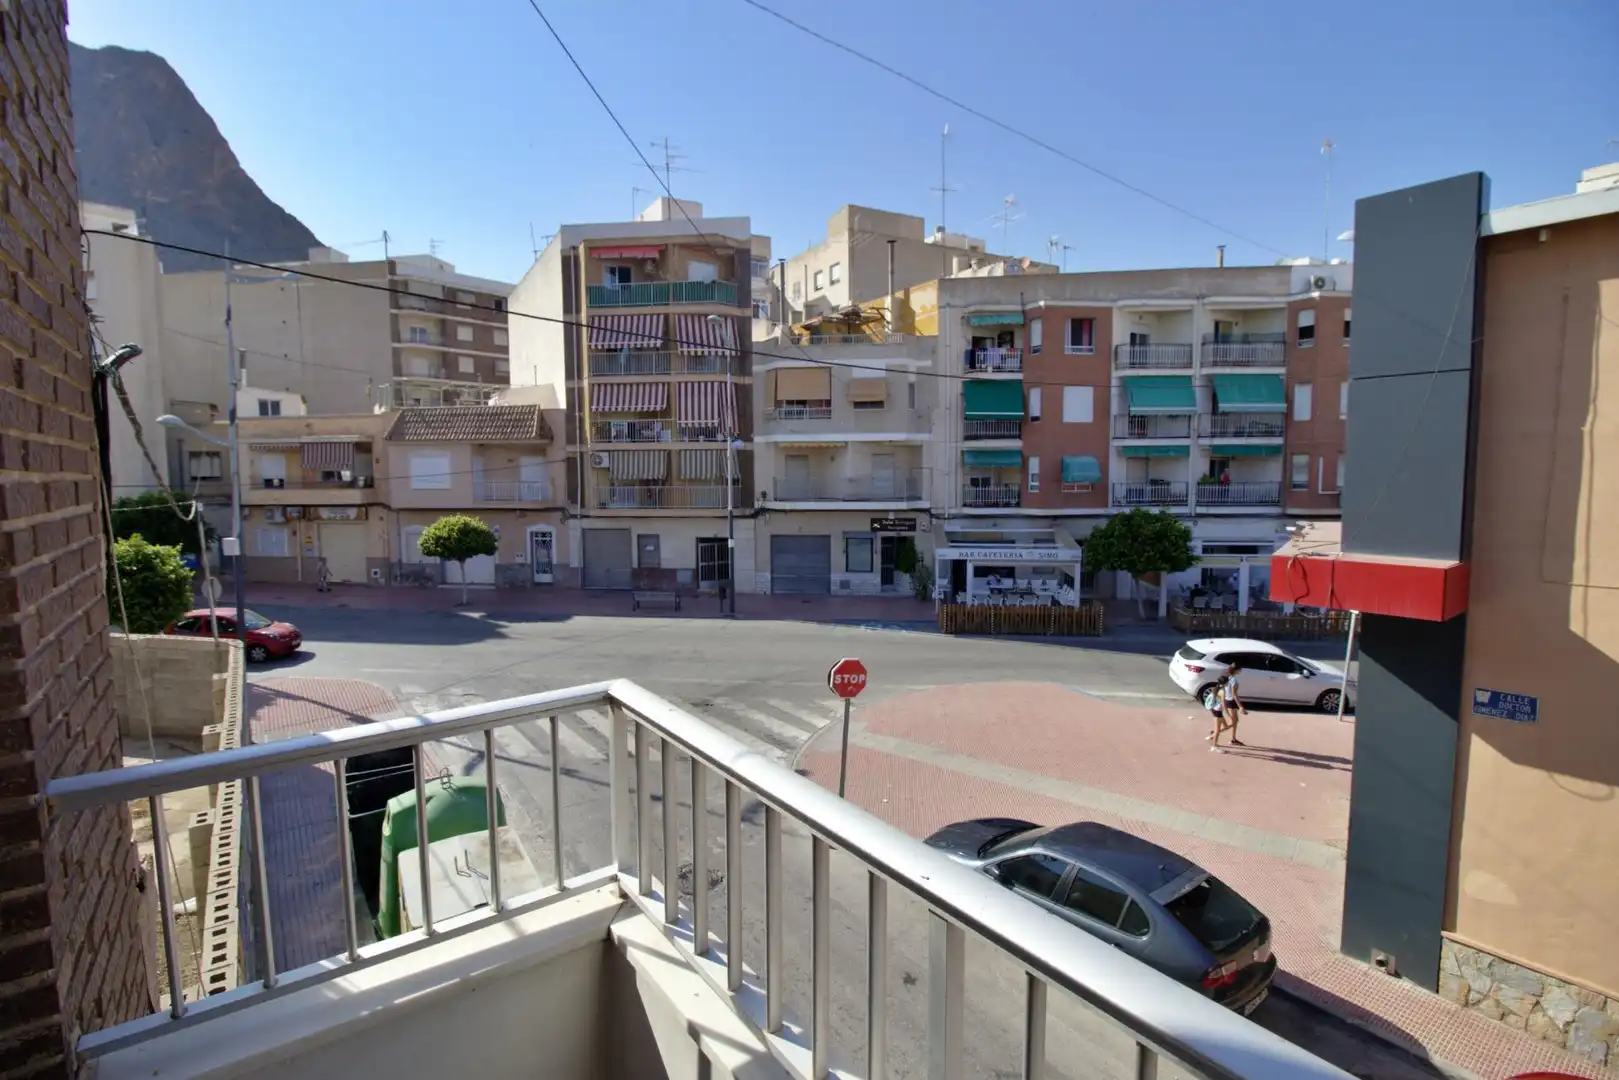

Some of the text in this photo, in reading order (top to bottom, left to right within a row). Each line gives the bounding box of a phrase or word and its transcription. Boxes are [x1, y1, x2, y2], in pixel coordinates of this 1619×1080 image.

[978, 551, 1023, 559] CAFETERIA
[834, 674, 865, 684] STOP
[1500, 693, 1530, 706] CALLE
[1499, 701, 1531, 713] DOCTOR
